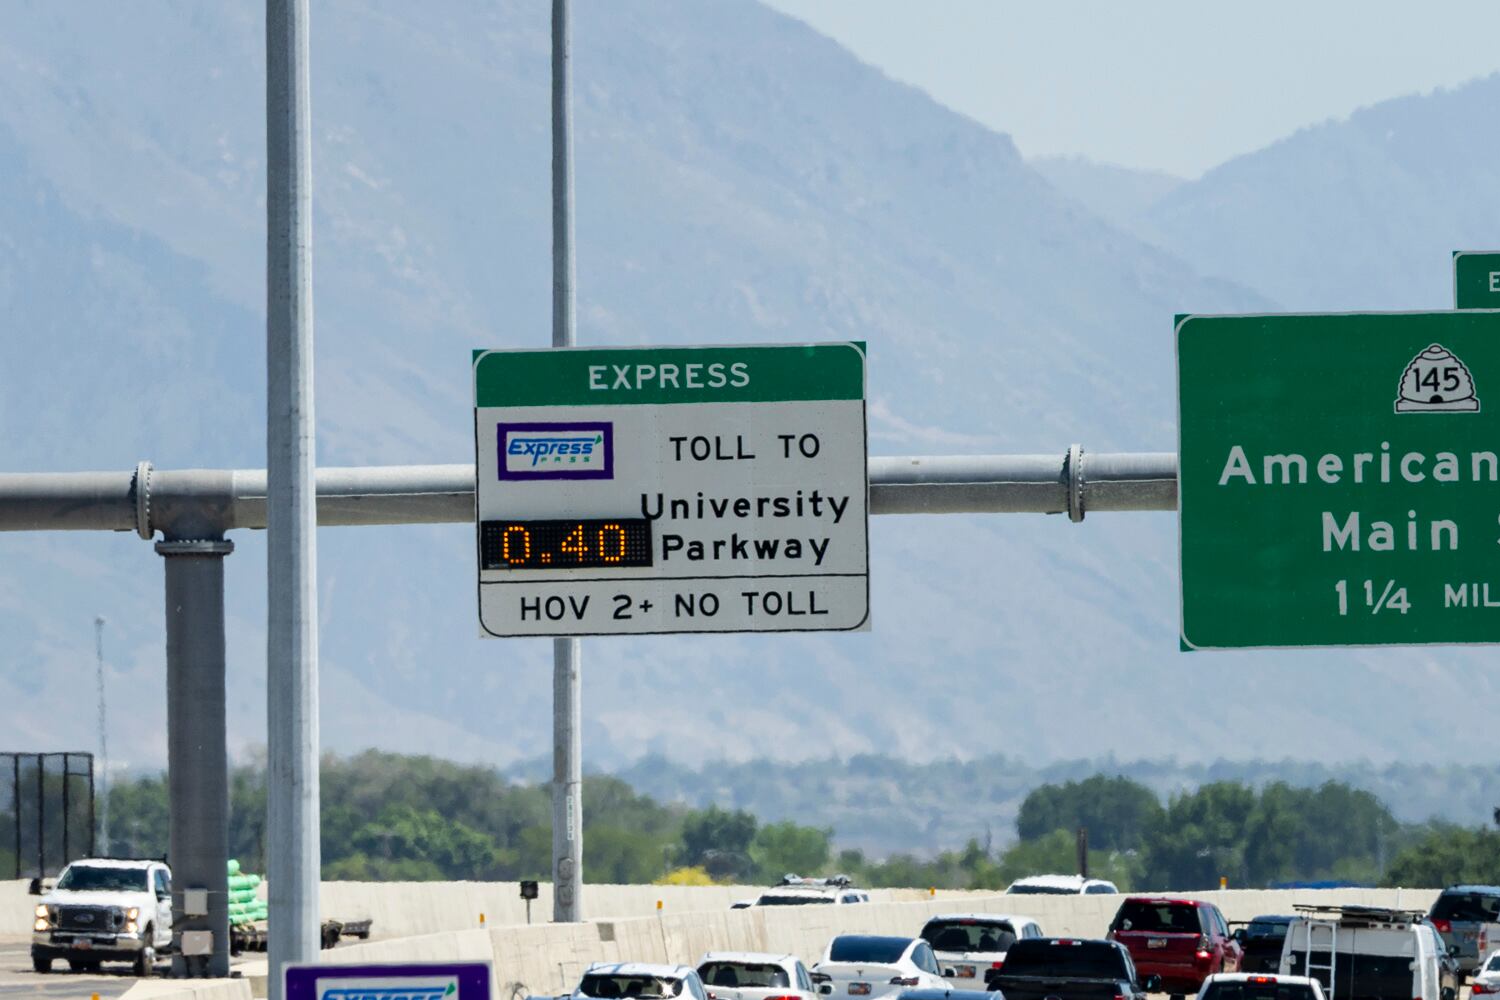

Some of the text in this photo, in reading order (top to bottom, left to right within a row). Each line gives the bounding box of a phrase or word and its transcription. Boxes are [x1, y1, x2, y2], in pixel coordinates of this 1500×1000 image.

[588, 363, 750, 390] EXPRESS
[1412, 367, 1460, 392] 145
[507, 436, 595, 466] Express
[669, 433, 820, 461] TOLL TO
[1218, 441, 1499, 485] American
[640, 490, 850, 524] University
[503, 524, 626, 563] 0.40
[1321, 510, 1459, 552] Main
[661, 532, 831, 566] Parkway
[521, 591, 829, 620] HOV 2+ NO TOLL
